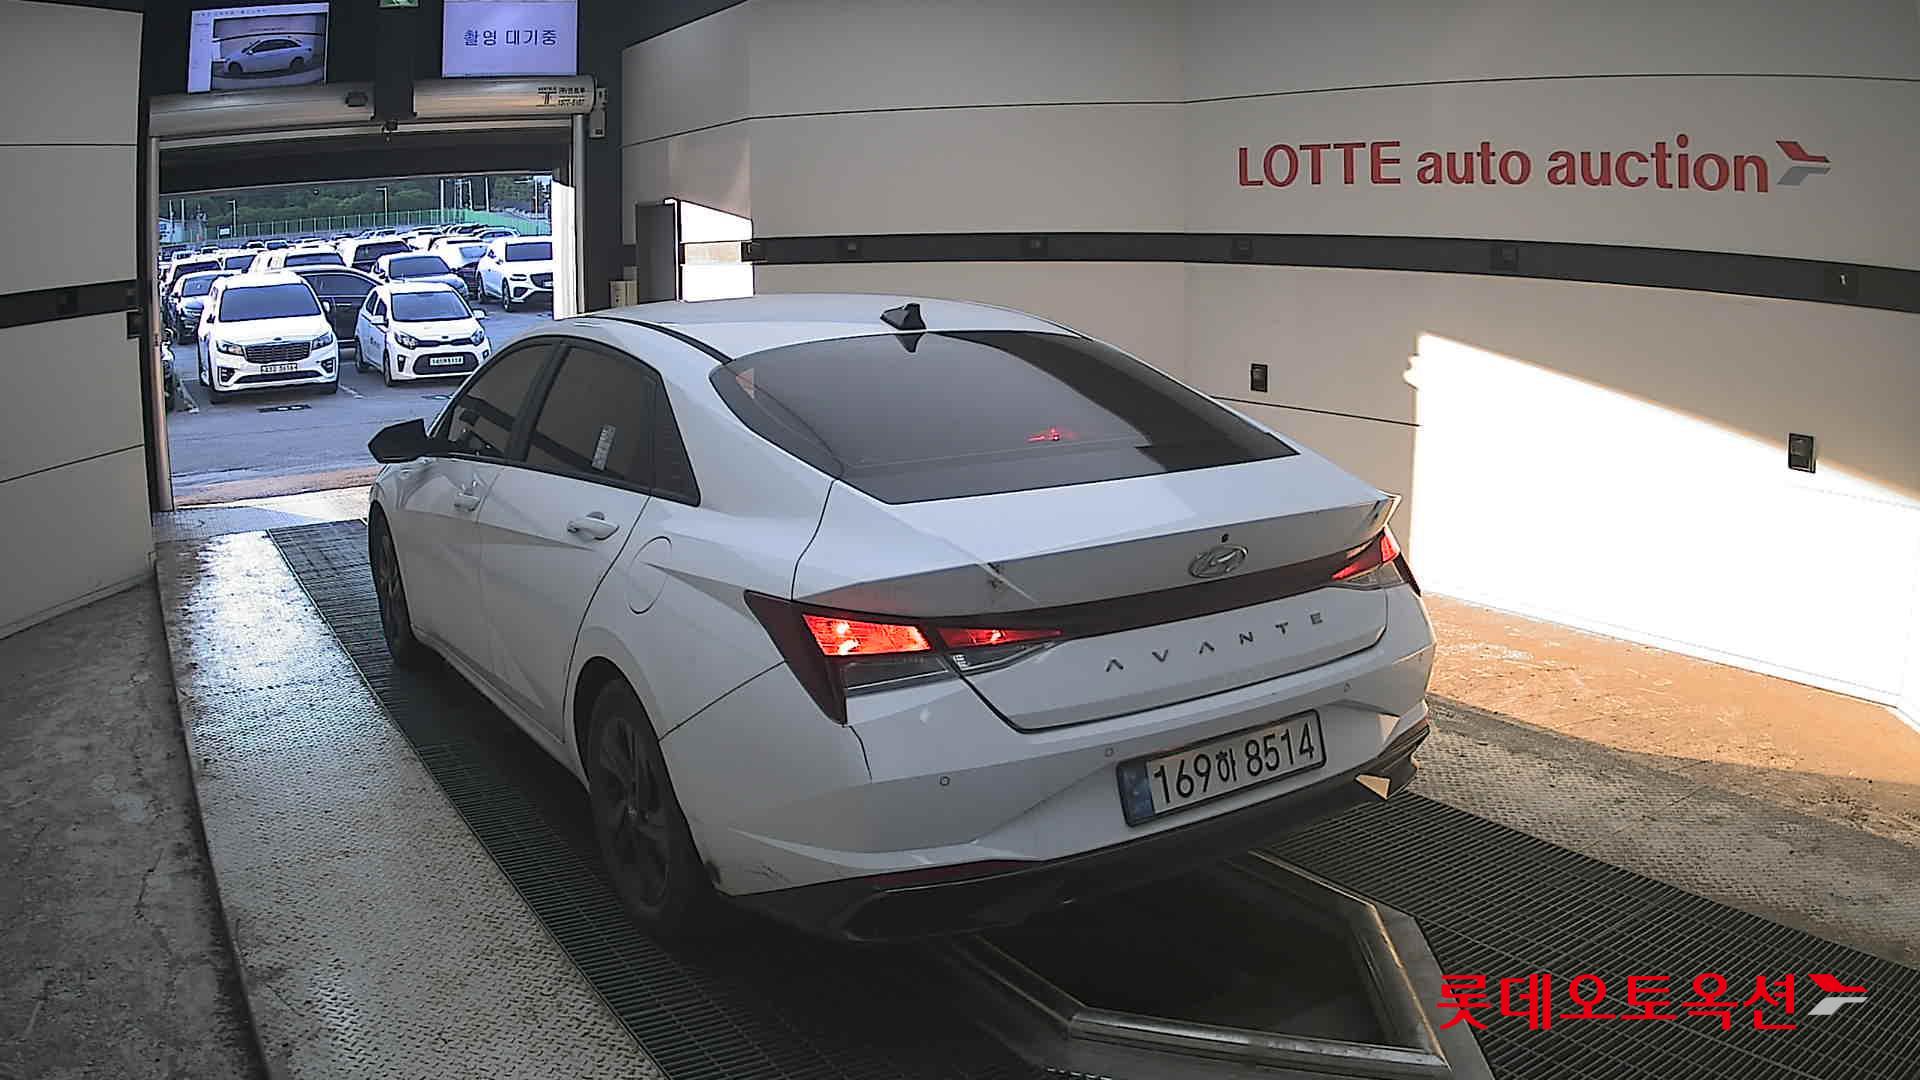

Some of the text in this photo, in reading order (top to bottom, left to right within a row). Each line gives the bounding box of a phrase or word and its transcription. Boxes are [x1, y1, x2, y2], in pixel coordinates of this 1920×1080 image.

[464, 29, 557, 46] 촬영 대기중
[1239, 134, 1769, 193] LOTTE auto auction
[1105, 612, 1323, 673] AVANTE
[1154, 722, 1315, 804] 169하 8514
